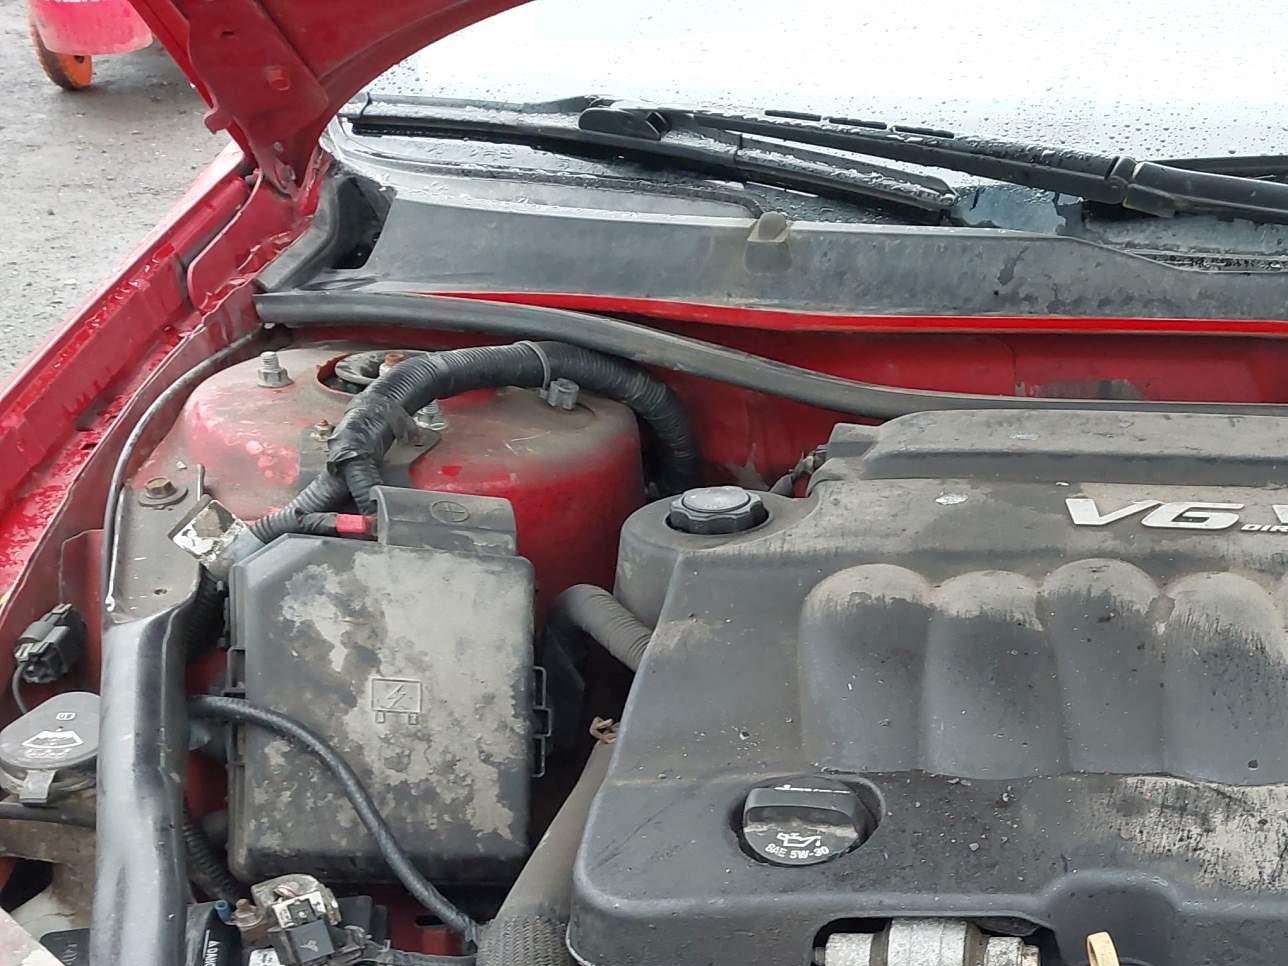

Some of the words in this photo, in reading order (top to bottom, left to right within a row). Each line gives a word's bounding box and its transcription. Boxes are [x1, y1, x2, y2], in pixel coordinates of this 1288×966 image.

[1065, 498, 1245, 530] V6
[765, 843, 788, 858] SAE
[789, 846, 830, 859] 5W-30
